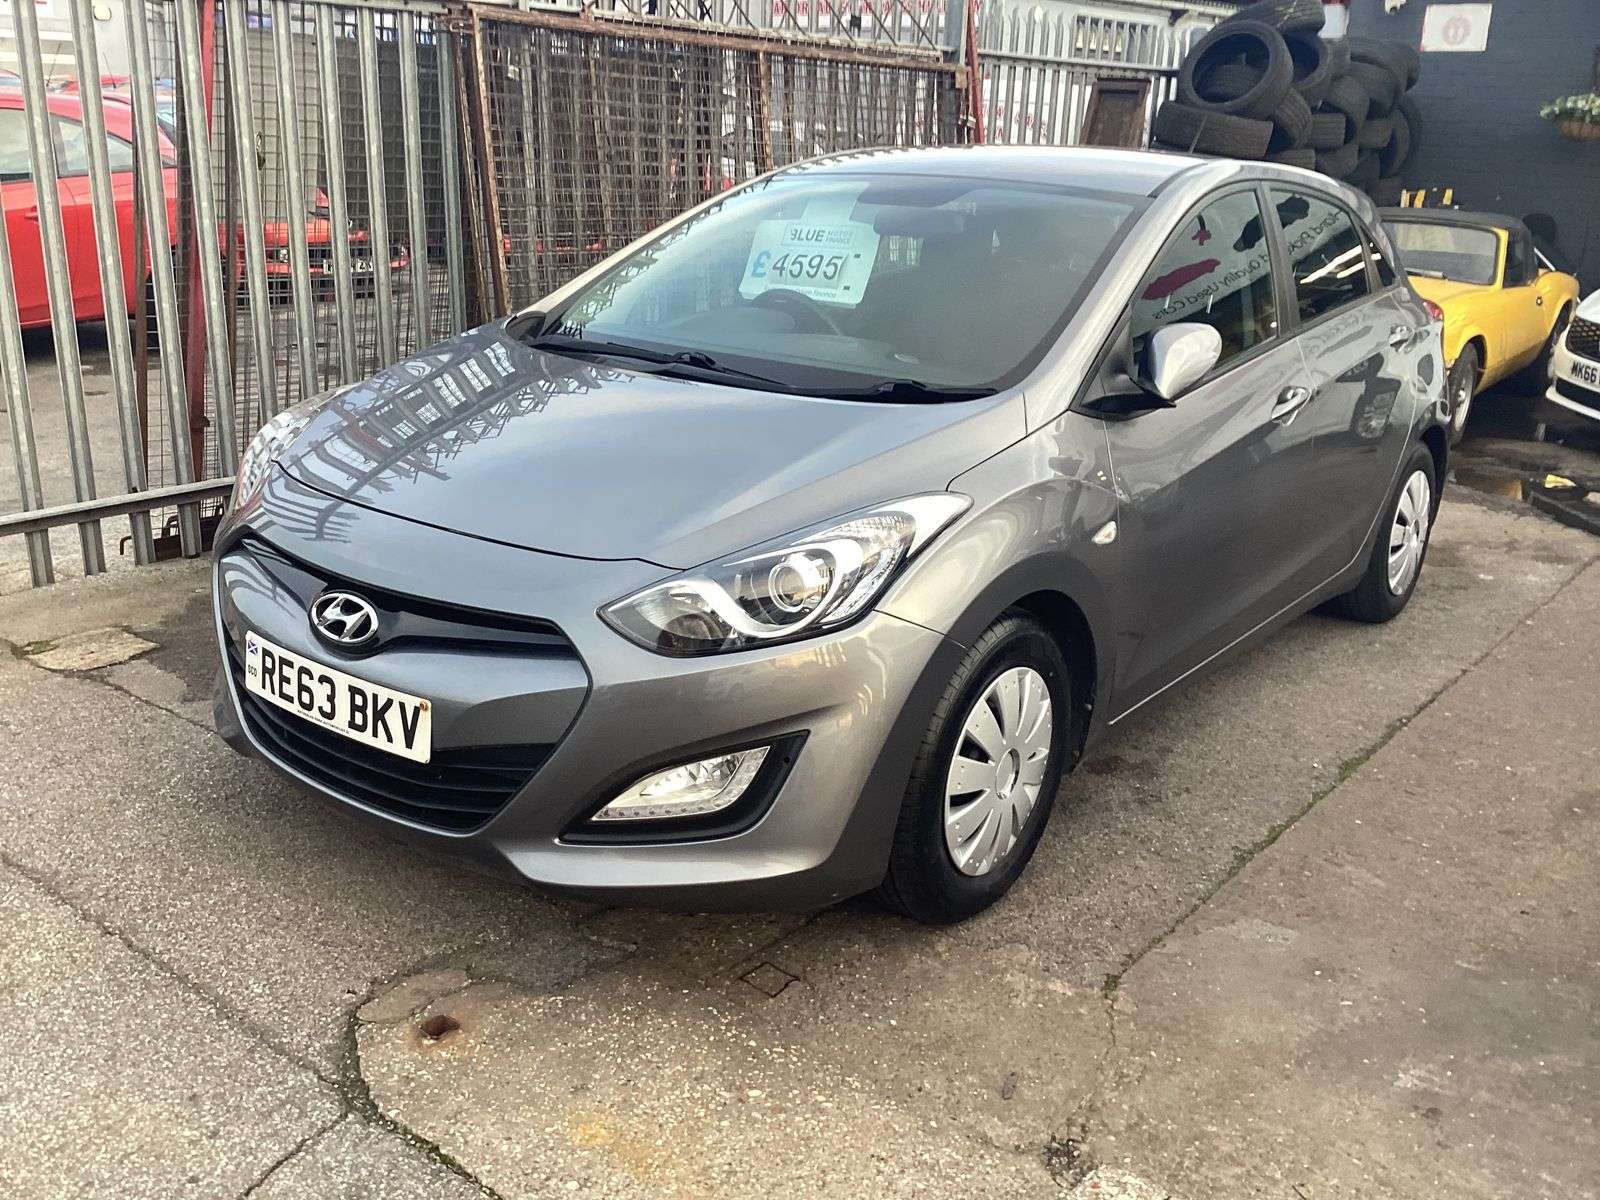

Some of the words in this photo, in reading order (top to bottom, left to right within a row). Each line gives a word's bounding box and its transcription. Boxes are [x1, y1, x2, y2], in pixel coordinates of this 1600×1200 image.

[789, 228, 826, 242] BLUE
[1571, 361, 1598, 383] MK66
[261, 646, 336, 721] RE63
[347, 684, 421, 750] BKV
